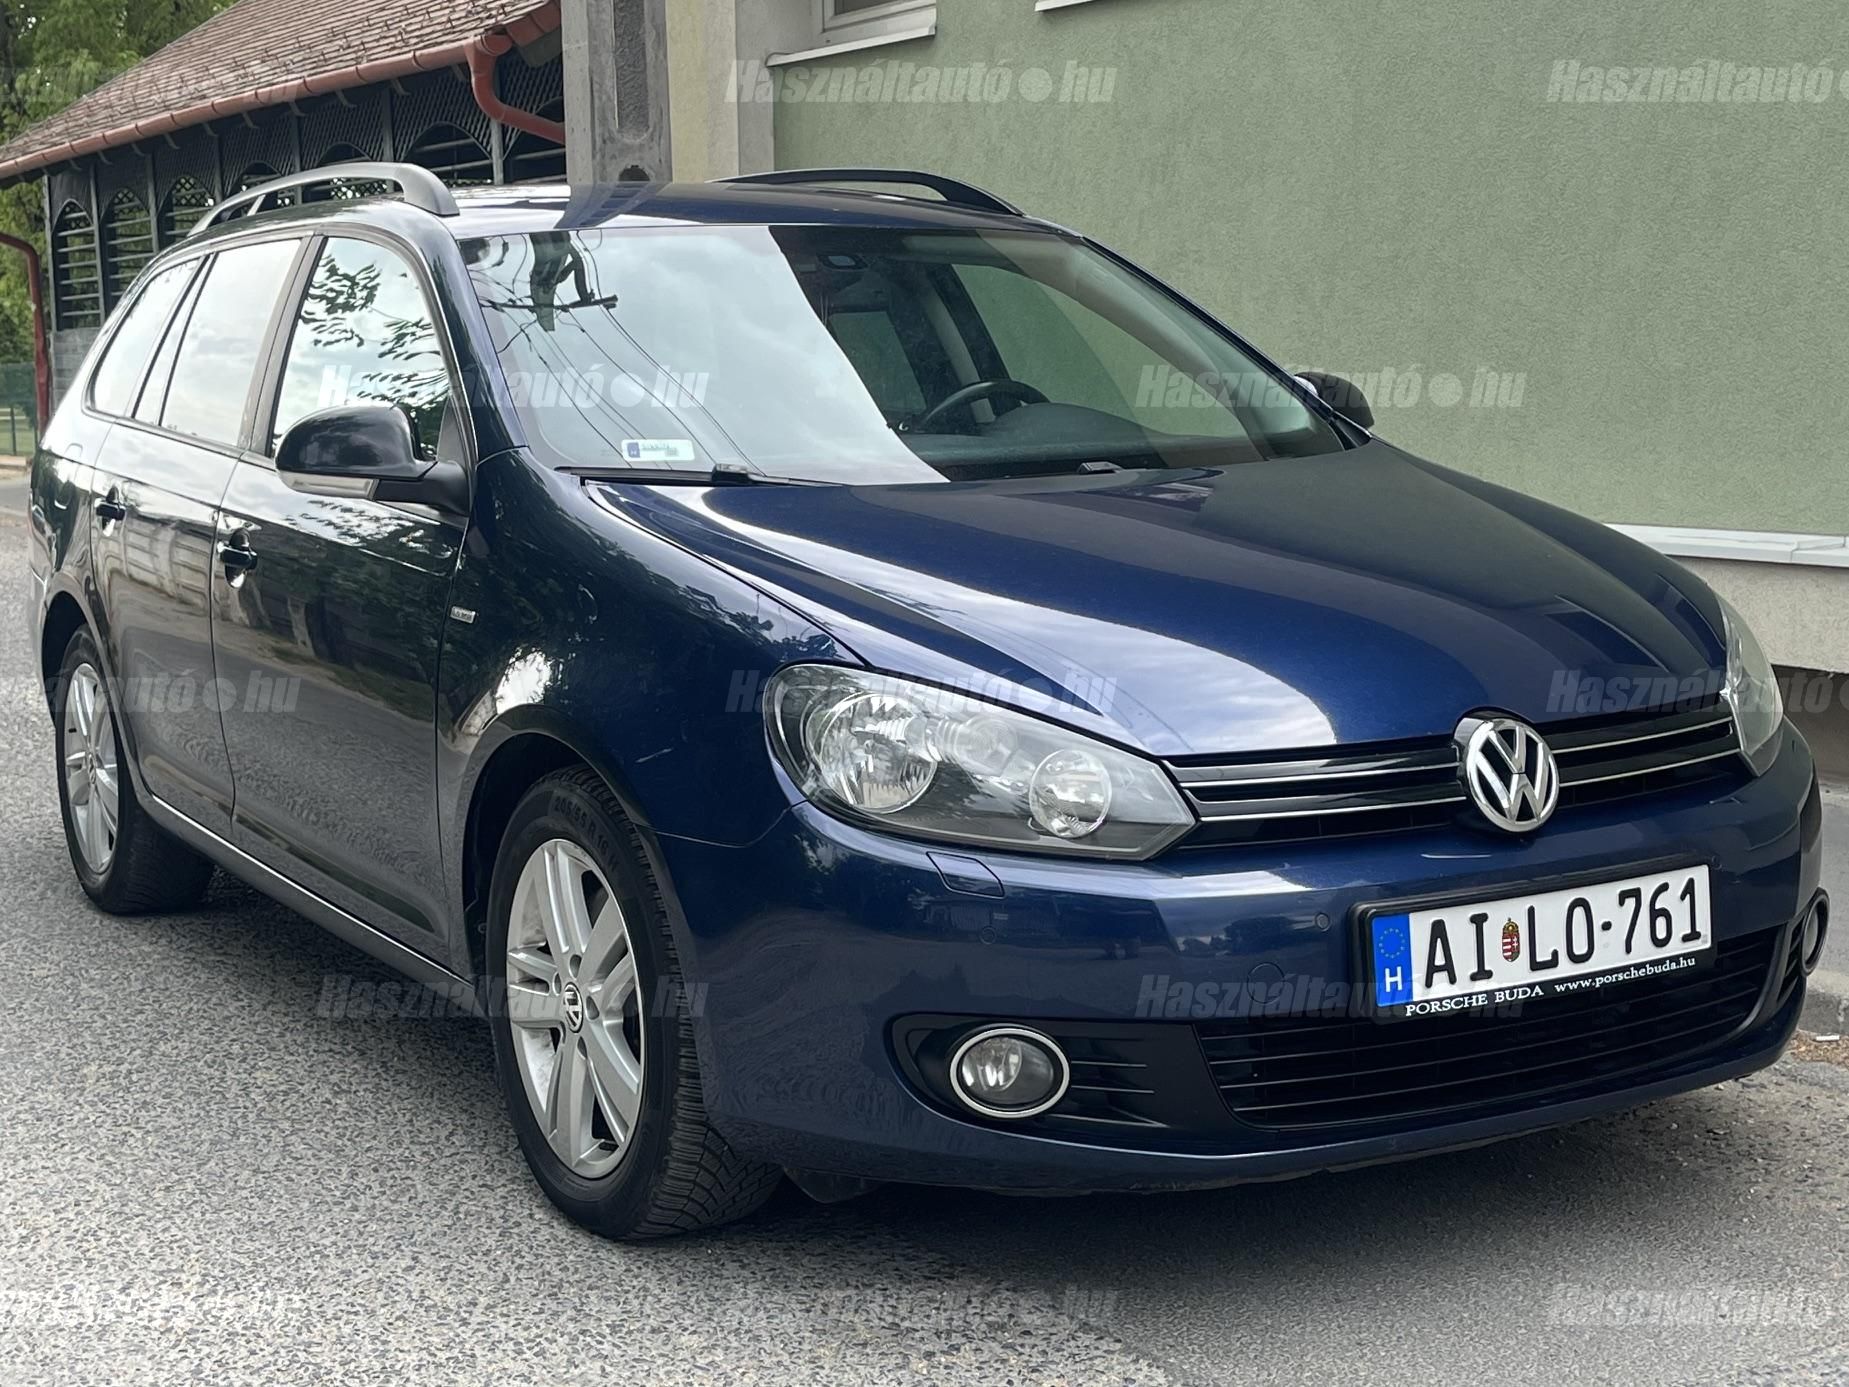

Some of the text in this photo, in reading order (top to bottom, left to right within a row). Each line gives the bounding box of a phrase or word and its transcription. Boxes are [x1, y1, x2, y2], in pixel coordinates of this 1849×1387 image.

[1384, 965, 1403, 993] H
[1405, 956, 1697, 1017] PORSCHE BUDA www.porschebuda.hu
